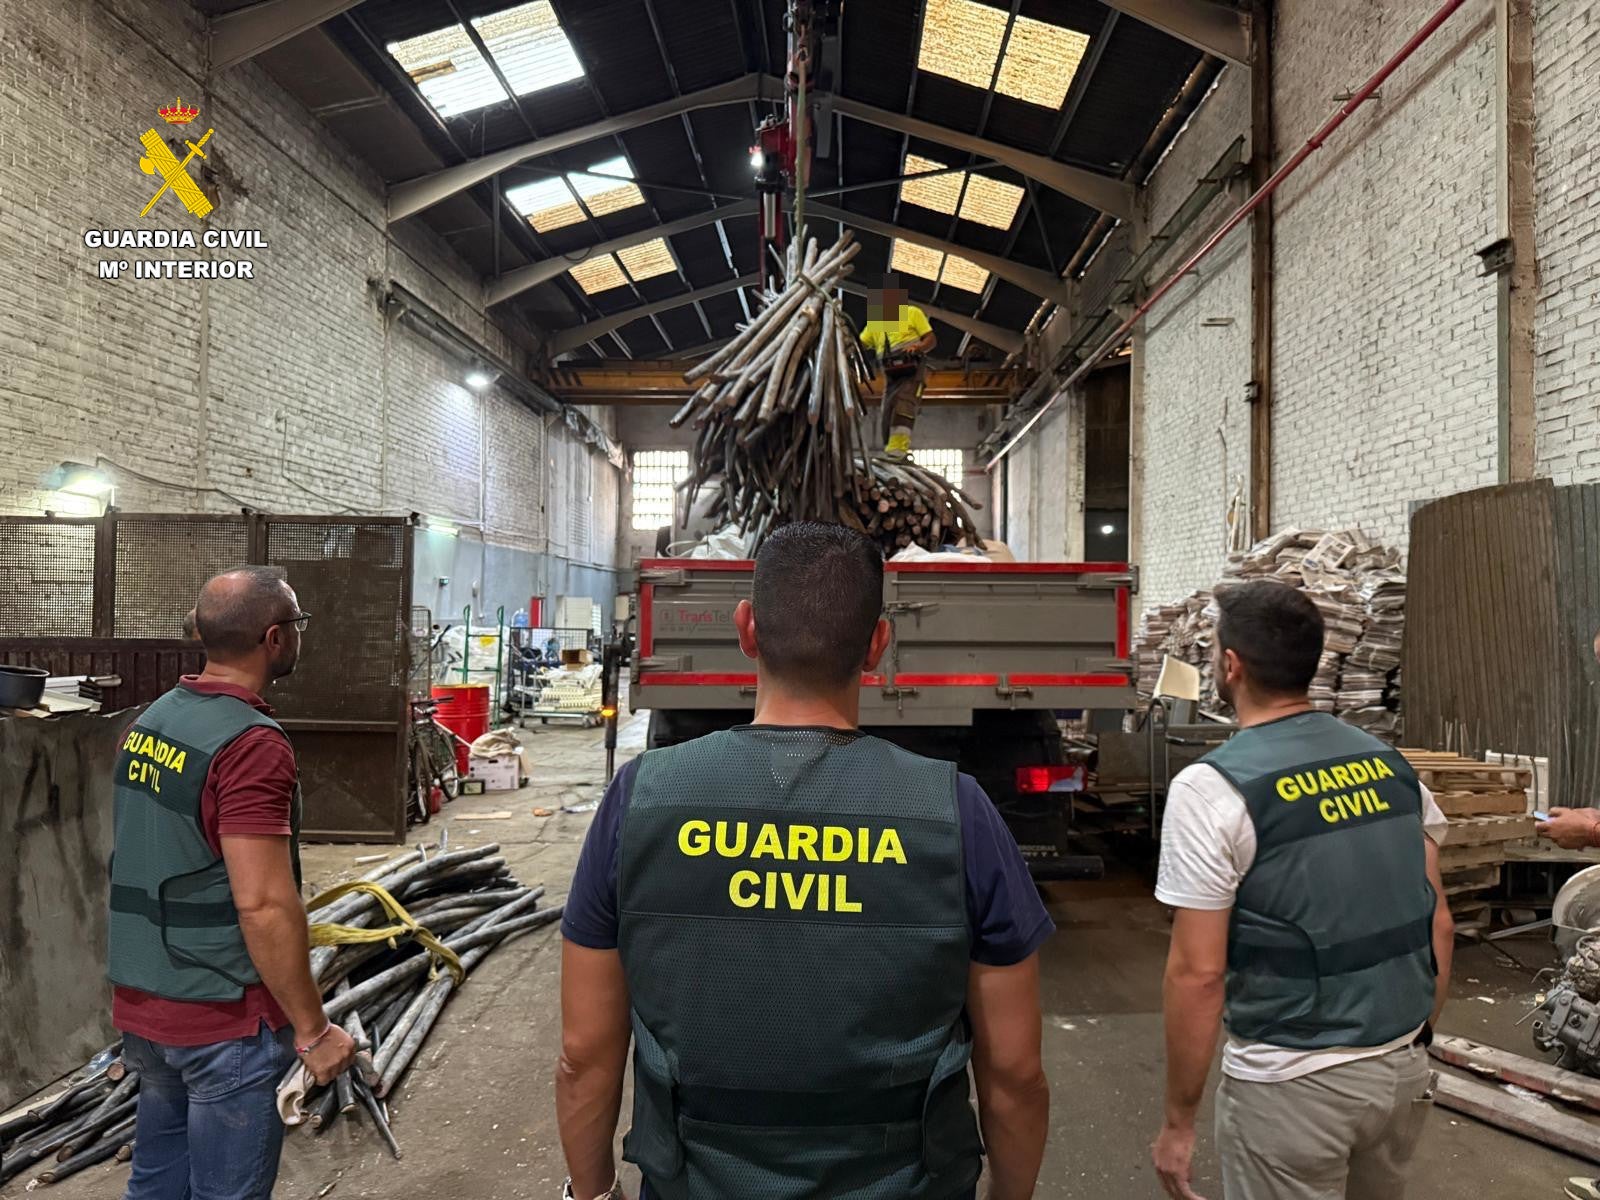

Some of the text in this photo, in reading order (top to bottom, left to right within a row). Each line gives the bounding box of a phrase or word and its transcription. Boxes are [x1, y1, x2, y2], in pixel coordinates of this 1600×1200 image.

[123, 731, 187, 774] GUADIA
[1275, 757, 1395, 802] GUARDIA
[1319, 787, 1391, 823] CIVIL
[678, 820, 908, 864] GUARDIA
[728, 870, 862, 913] CIVIL
